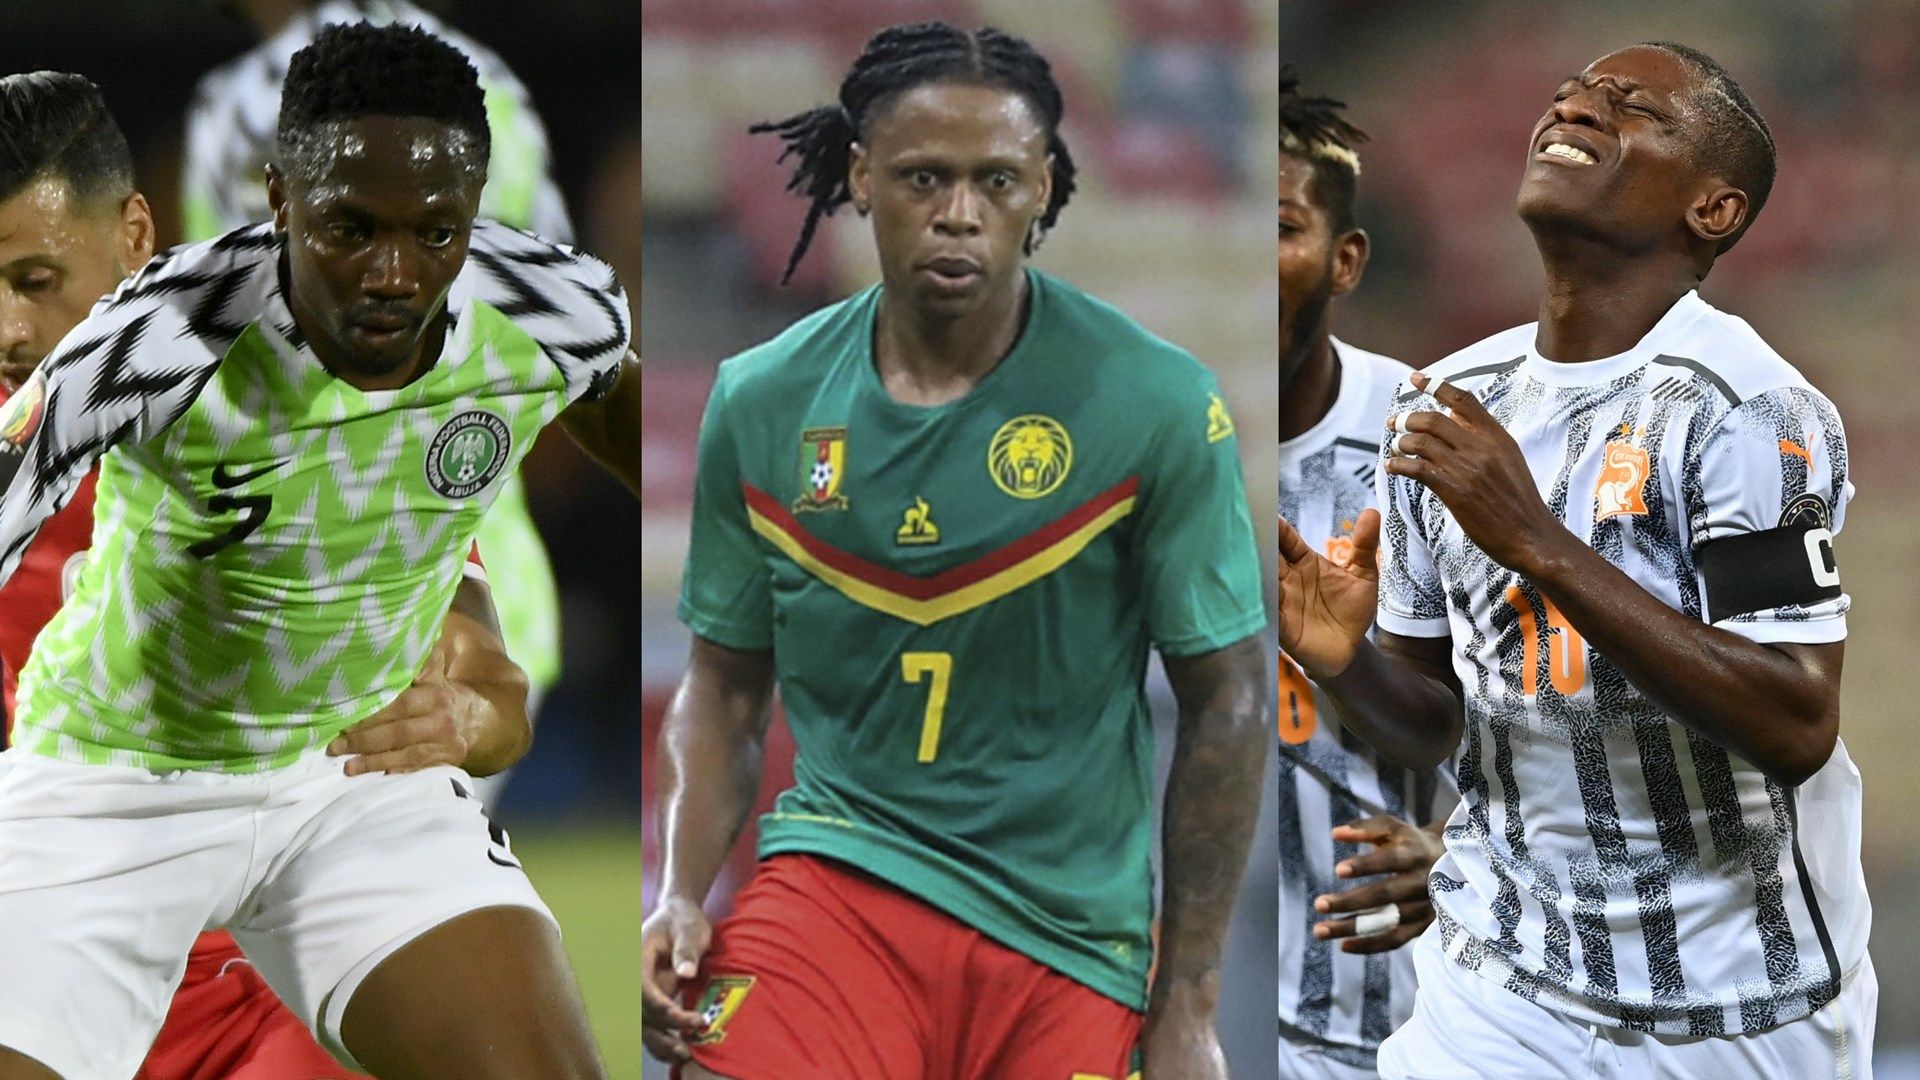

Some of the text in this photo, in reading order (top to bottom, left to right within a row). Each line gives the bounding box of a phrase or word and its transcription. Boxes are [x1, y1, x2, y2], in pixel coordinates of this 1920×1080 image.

[435, 413, 487, 446] FOOTBALL
[446, 481, 482, 497] ABUJA
[186, 494, 273, 560] 7
[1804, 527, 1840, 588] C
[902, 652, 952, 762] 7
